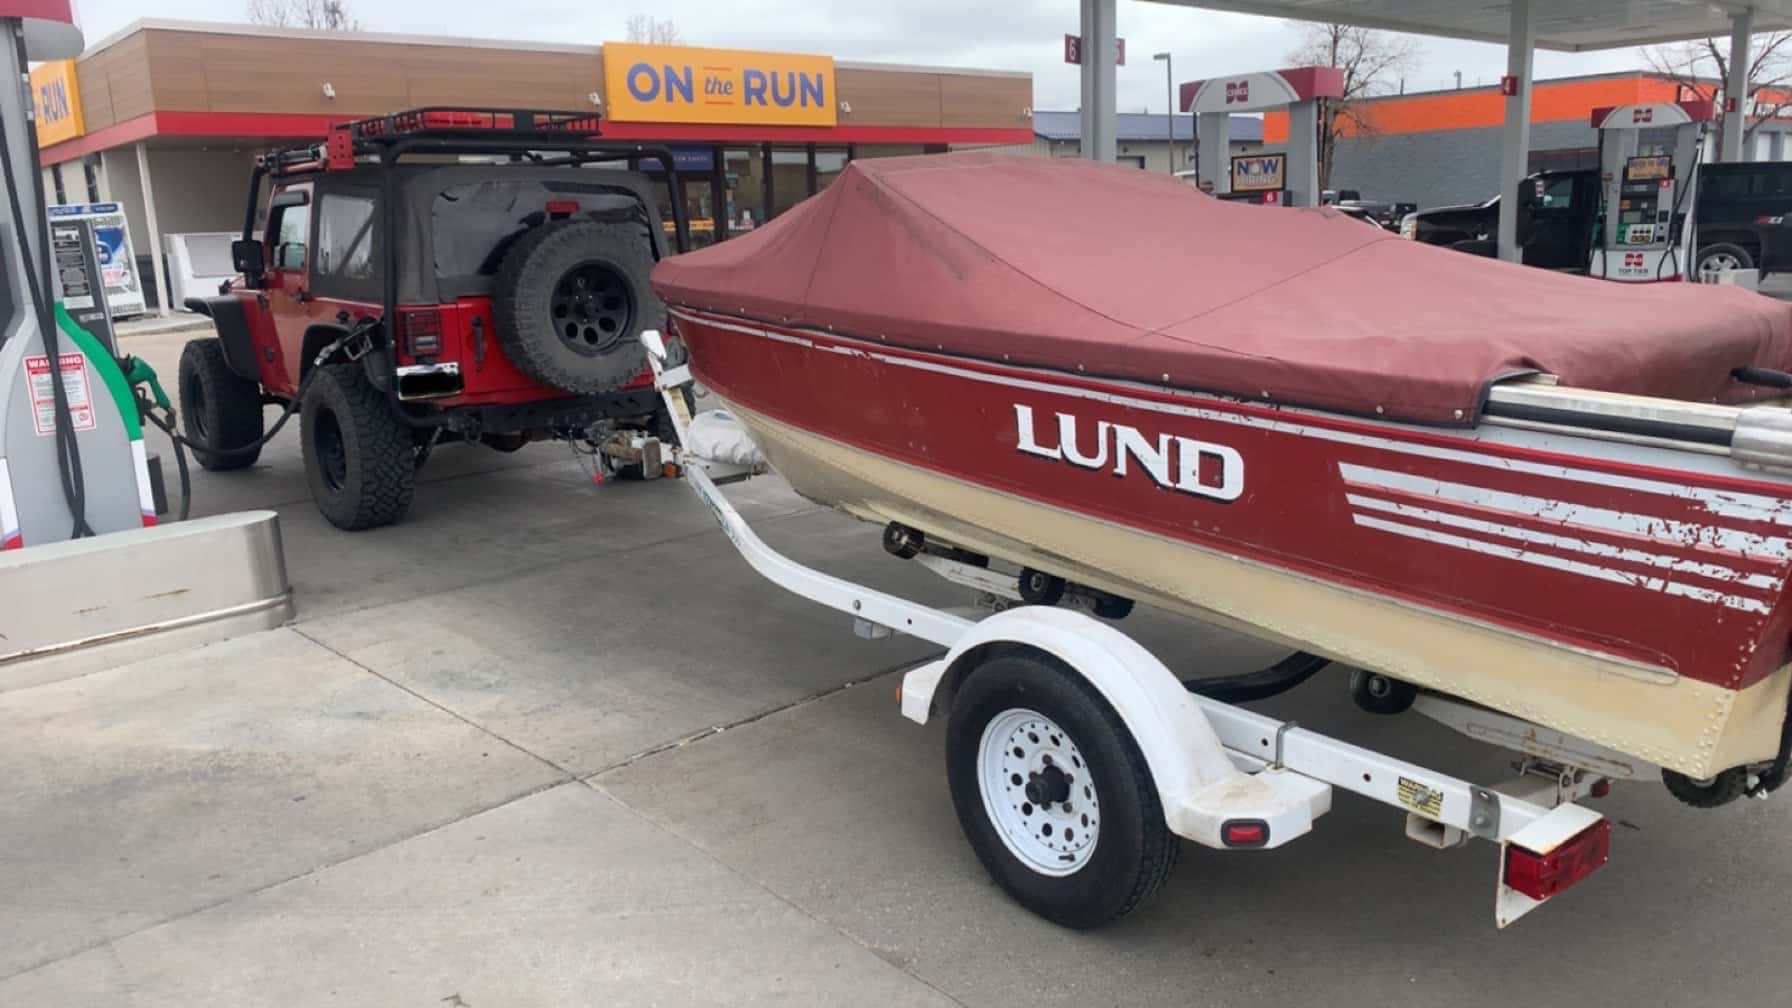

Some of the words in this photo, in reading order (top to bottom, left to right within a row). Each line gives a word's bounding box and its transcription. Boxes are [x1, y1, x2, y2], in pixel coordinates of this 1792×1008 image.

[1069, 39, 1076, 61] 6
[41, 75, 69, 124] RUN
[627, 63, 694, 103] ON
[704, 77, 734, 96] the
[742, 68, 825, 107] RUN
[1237, 159, 1279, 175] NOW
[27, 356, 82, 368] WAING
[1013, 403, 1245, 502] LUND
